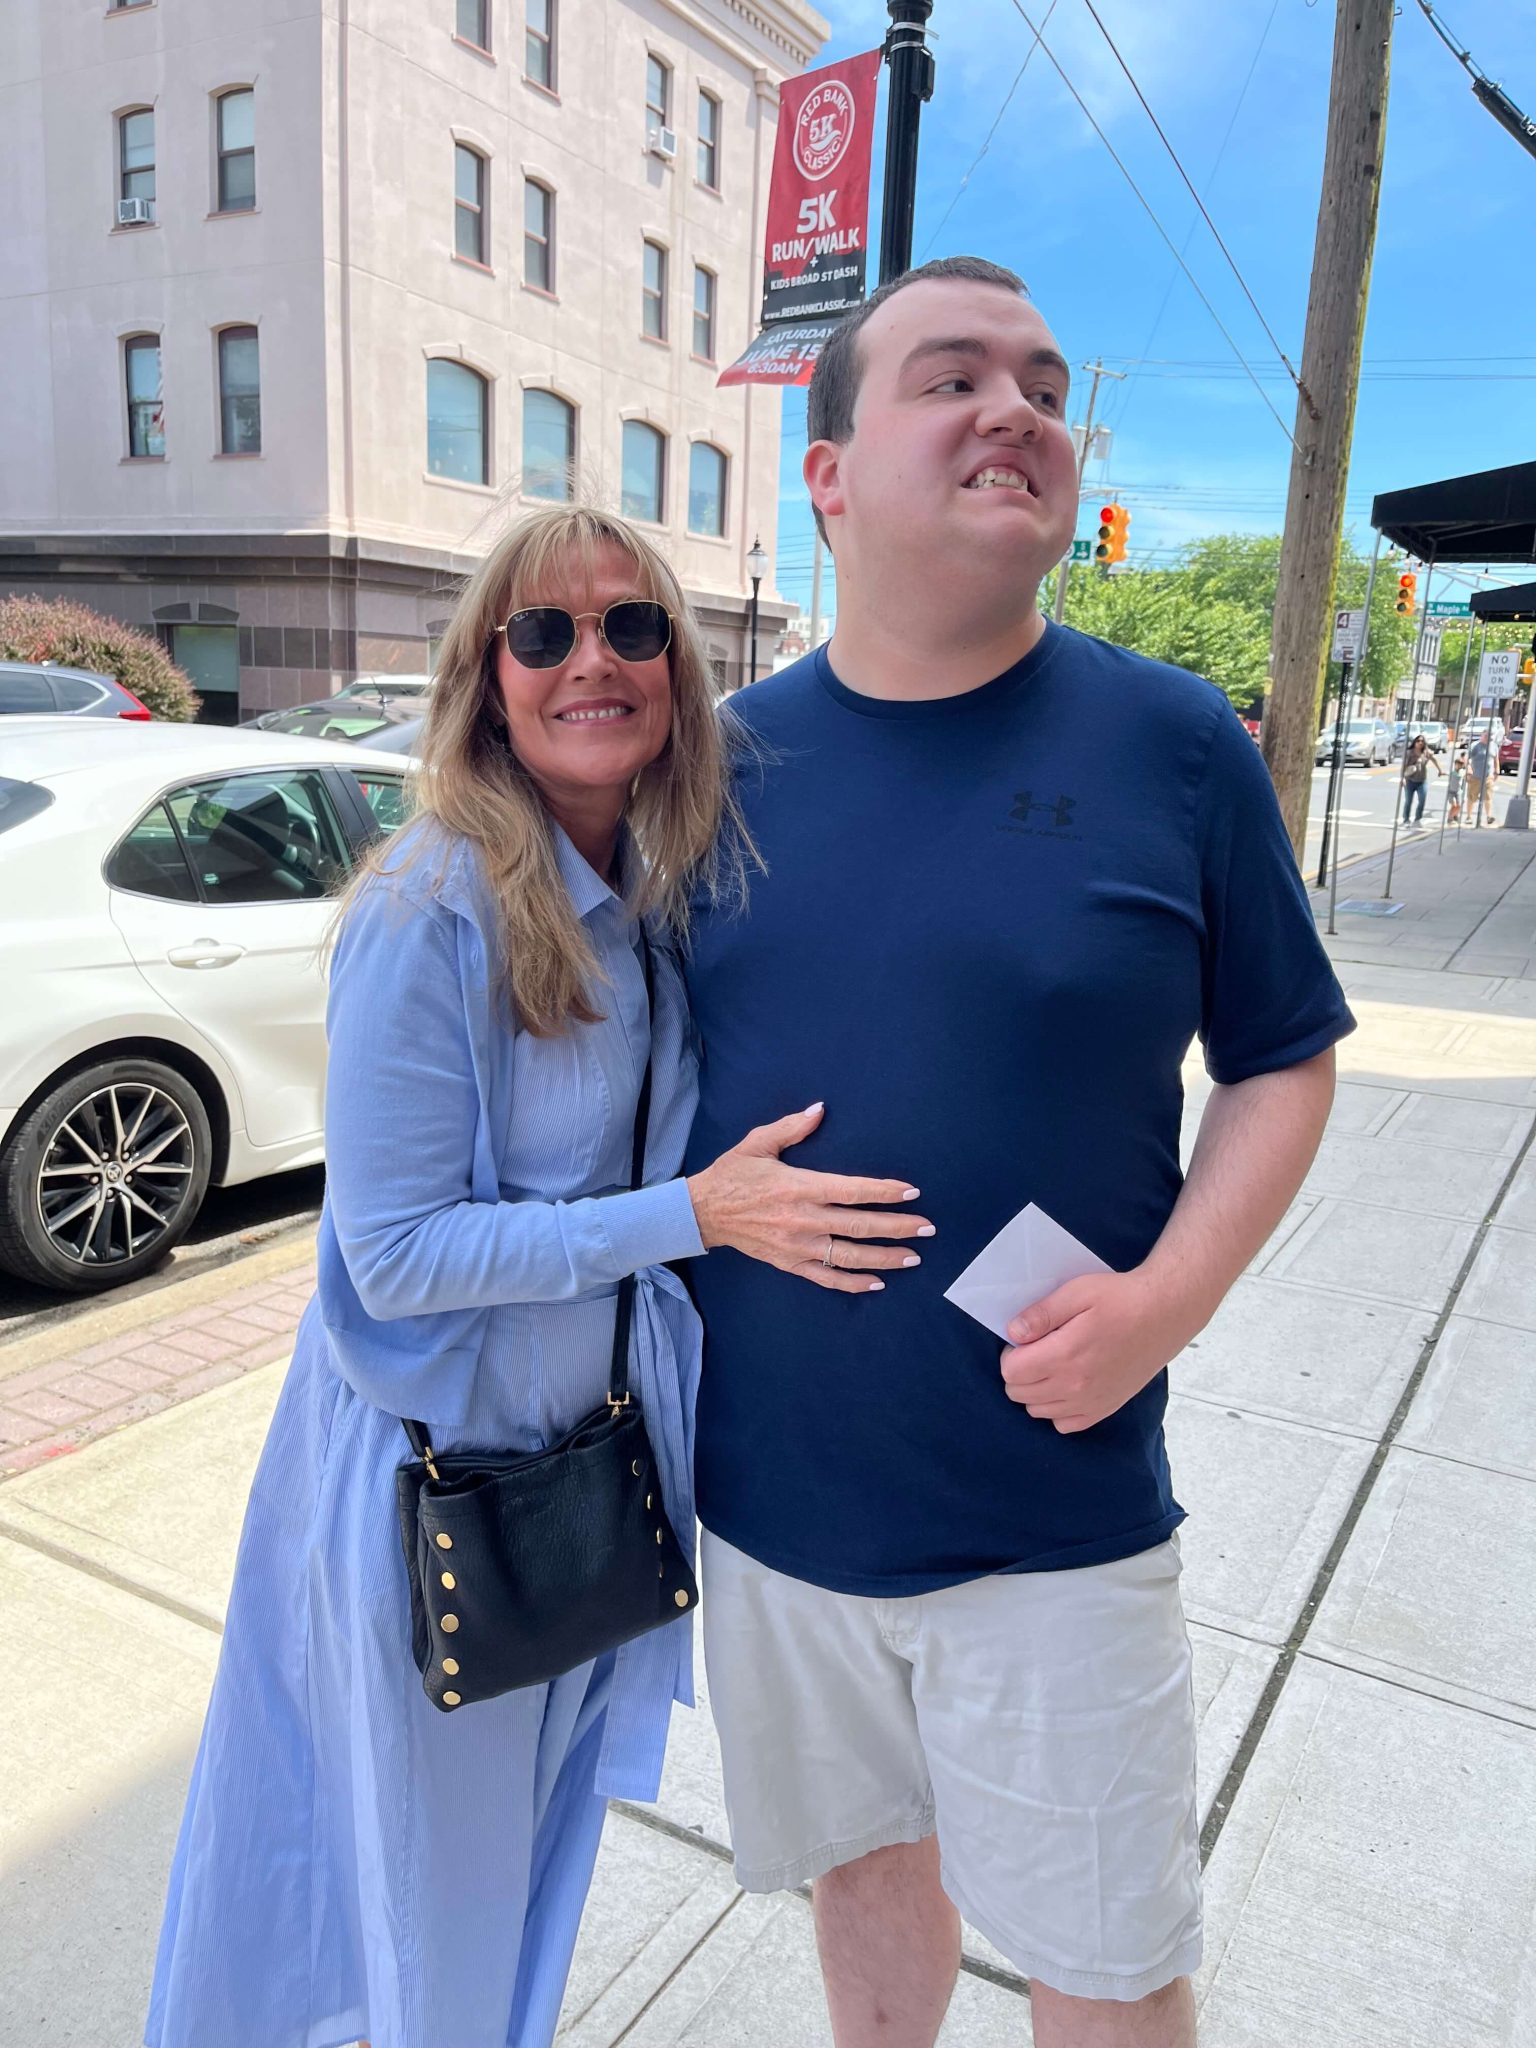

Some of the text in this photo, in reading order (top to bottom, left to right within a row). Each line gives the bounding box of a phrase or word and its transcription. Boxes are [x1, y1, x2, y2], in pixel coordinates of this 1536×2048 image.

[801, 89, 848, 126] RED BANK
[809, 113, 837, 142] 5K
[803, 141, 840, 169] CLASSIC
[796, 189, 837, 234] 5K
[772, 227, 859, 262] RUN/WALK
[770, 266, 858, 290] KIDS BROAD ST DASH
[764, 328, 835, 346] SATURDAY
[736, 343, 822, 365] JUNE 15
[1436, 604, 1460, 615] Maple
[1491, 655, 1509, 665] NO
[1488, 686, 1505, 694] RED
[1491, 676, 1503, 684] ON
